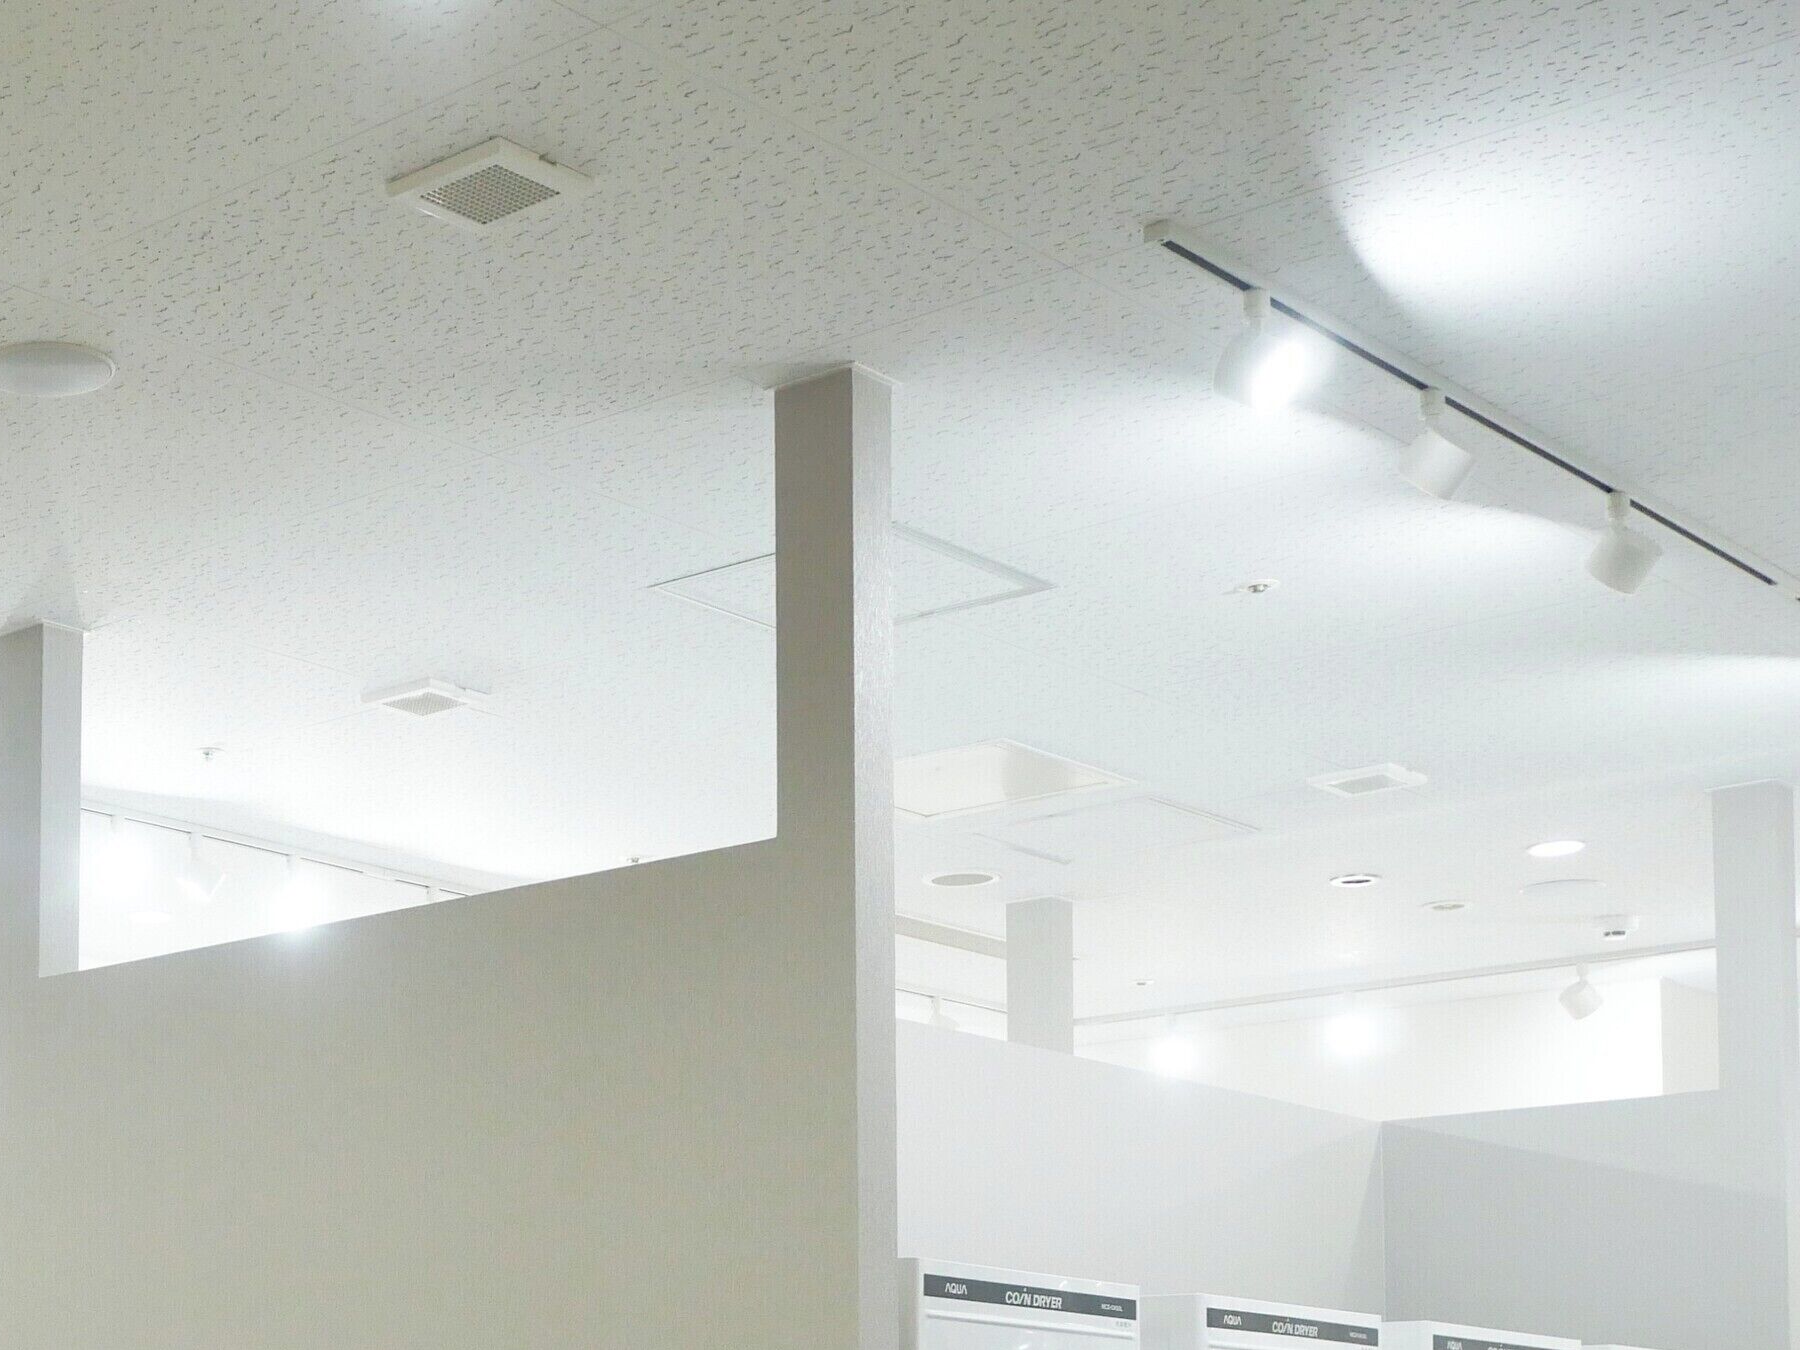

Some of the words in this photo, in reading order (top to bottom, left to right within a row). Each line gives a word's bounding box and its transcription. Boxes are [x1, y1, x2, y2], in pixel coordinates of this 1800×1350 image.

[945, 1282, 968, 1296] AQUA
[1032, 1294, 1063, 1310] DRYER
[1223, 1314, 1242, 1326] AQUA
[1294, 1324, 1319, 1338] DRYER
